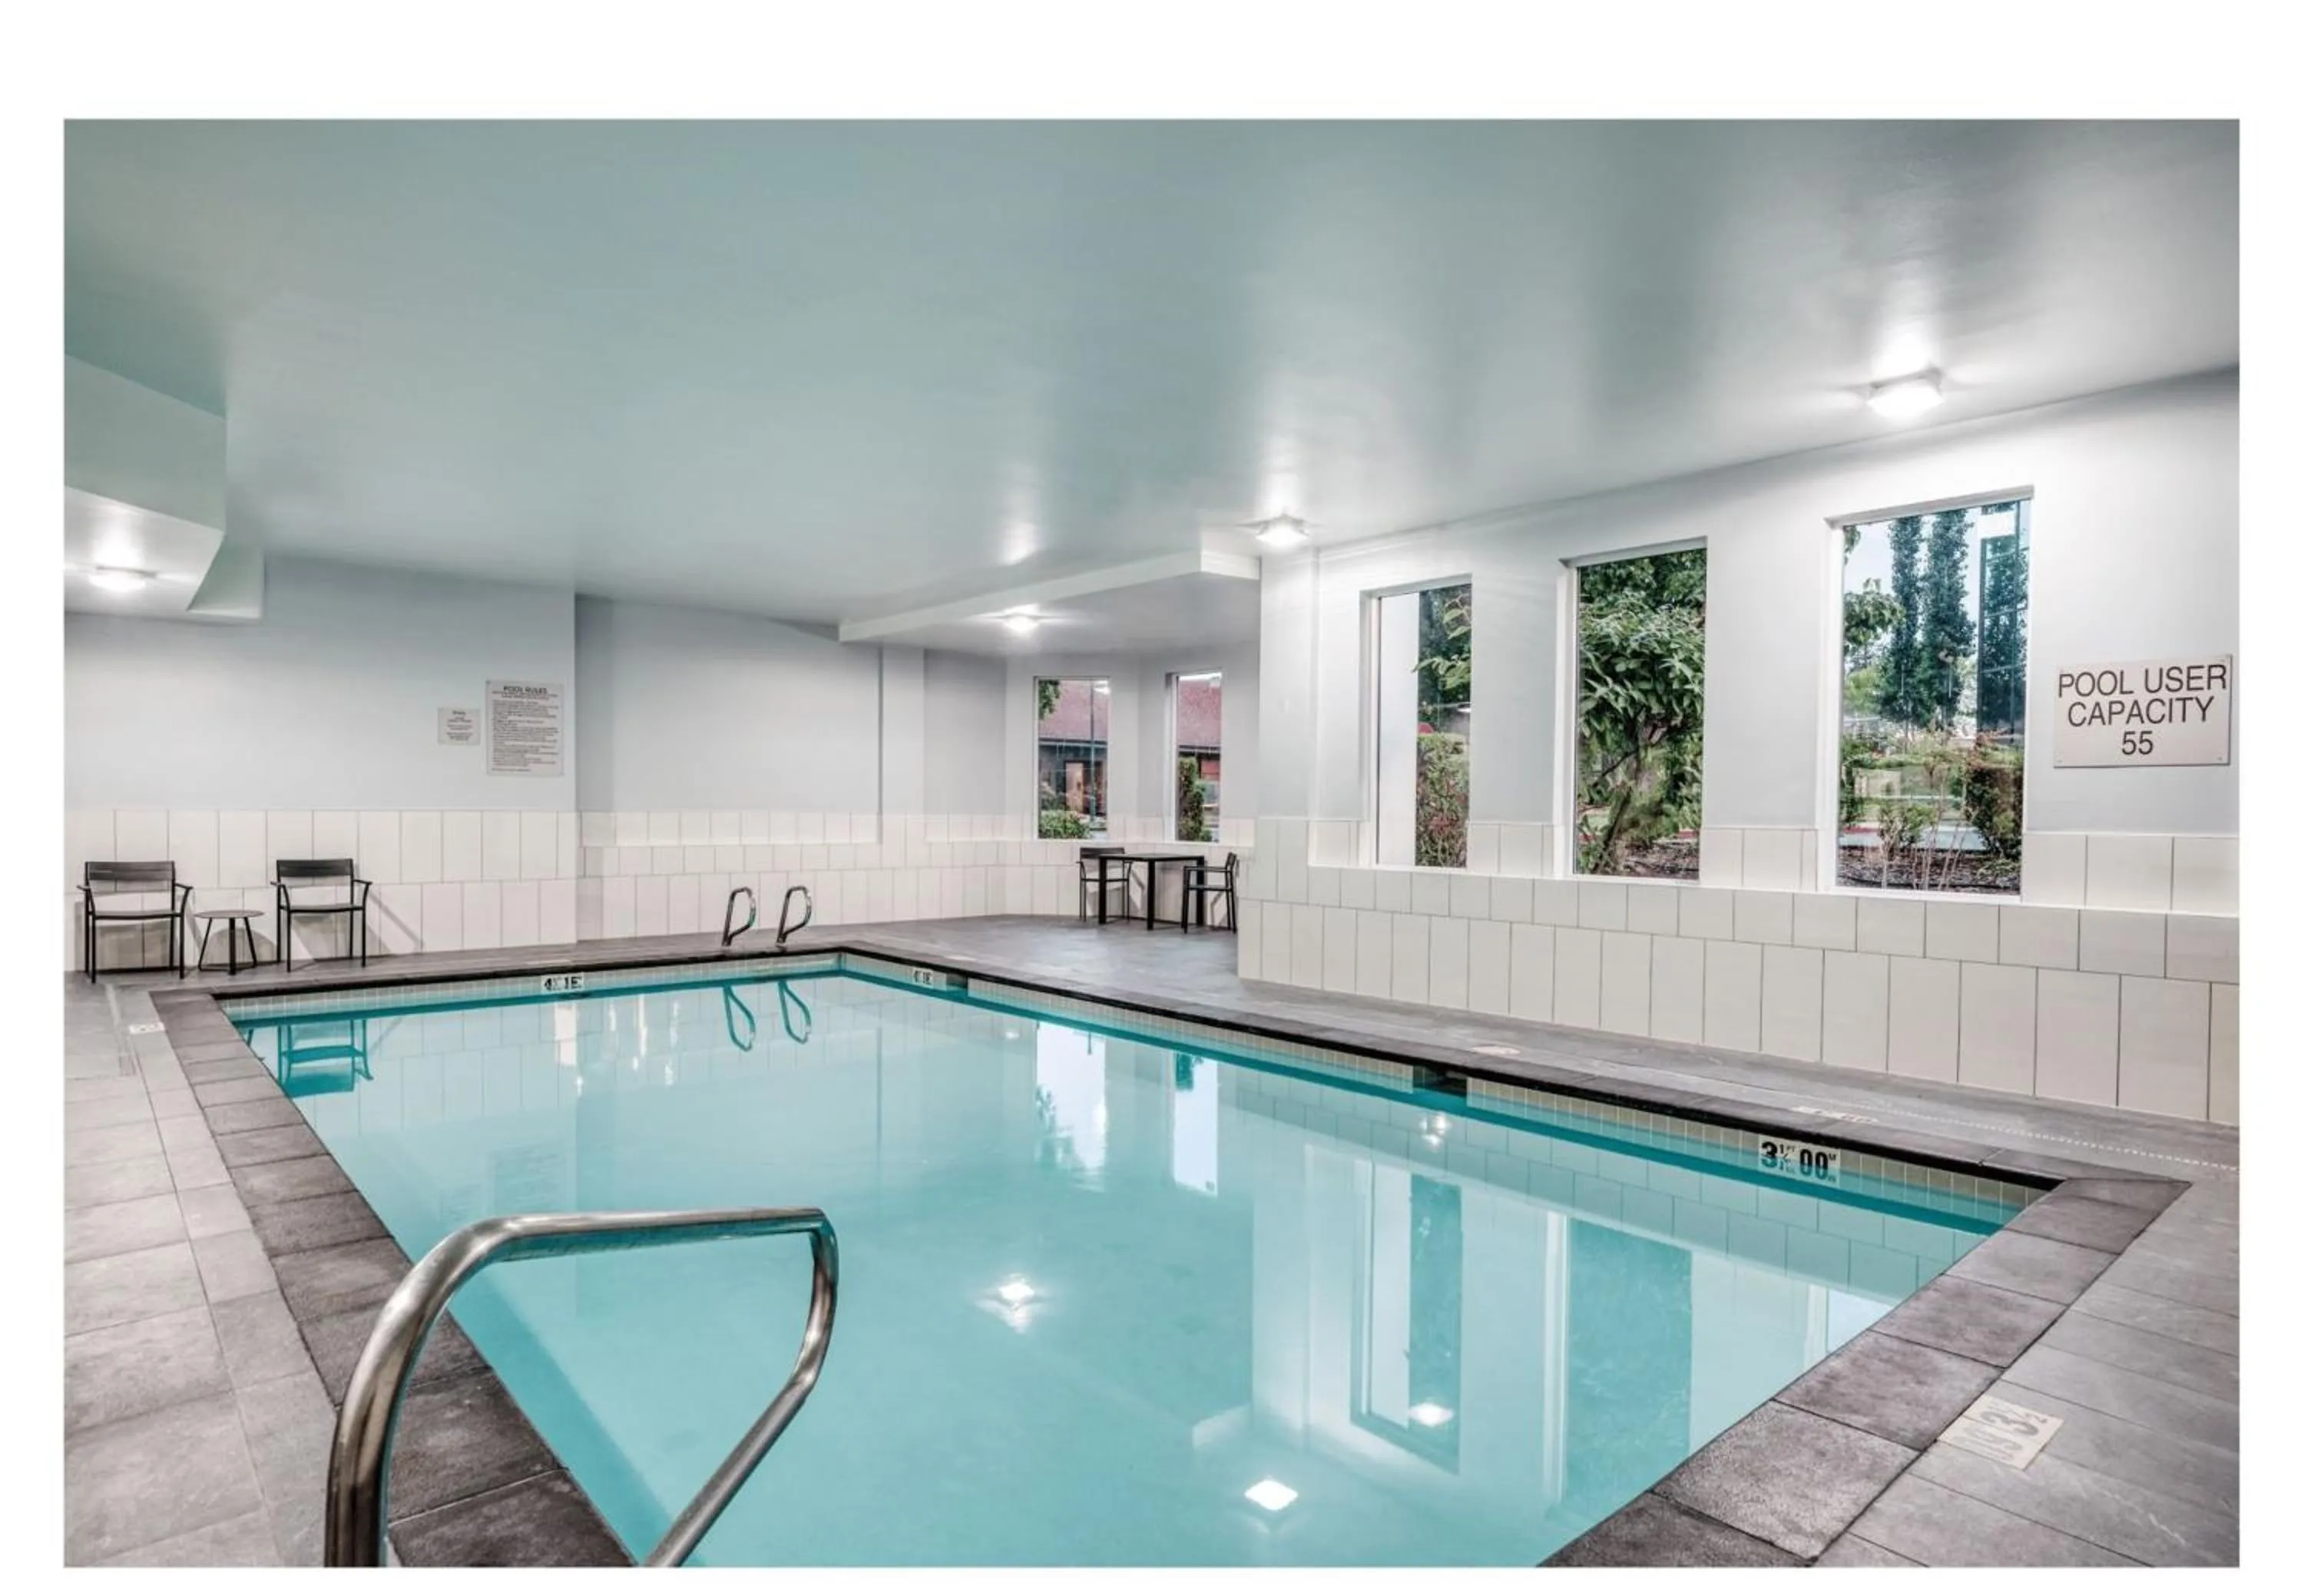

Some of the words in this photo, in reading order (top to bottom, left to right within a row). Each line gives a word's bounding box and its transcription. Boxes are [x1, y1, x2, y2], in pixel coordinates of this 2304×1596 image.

[2058, 670, 2134, 698] POOL
[2144, 664, 2227, 694] USER
[2067, 696, 2215, 727] CAPACITY
[2121, 730, 2154, 756] 55
